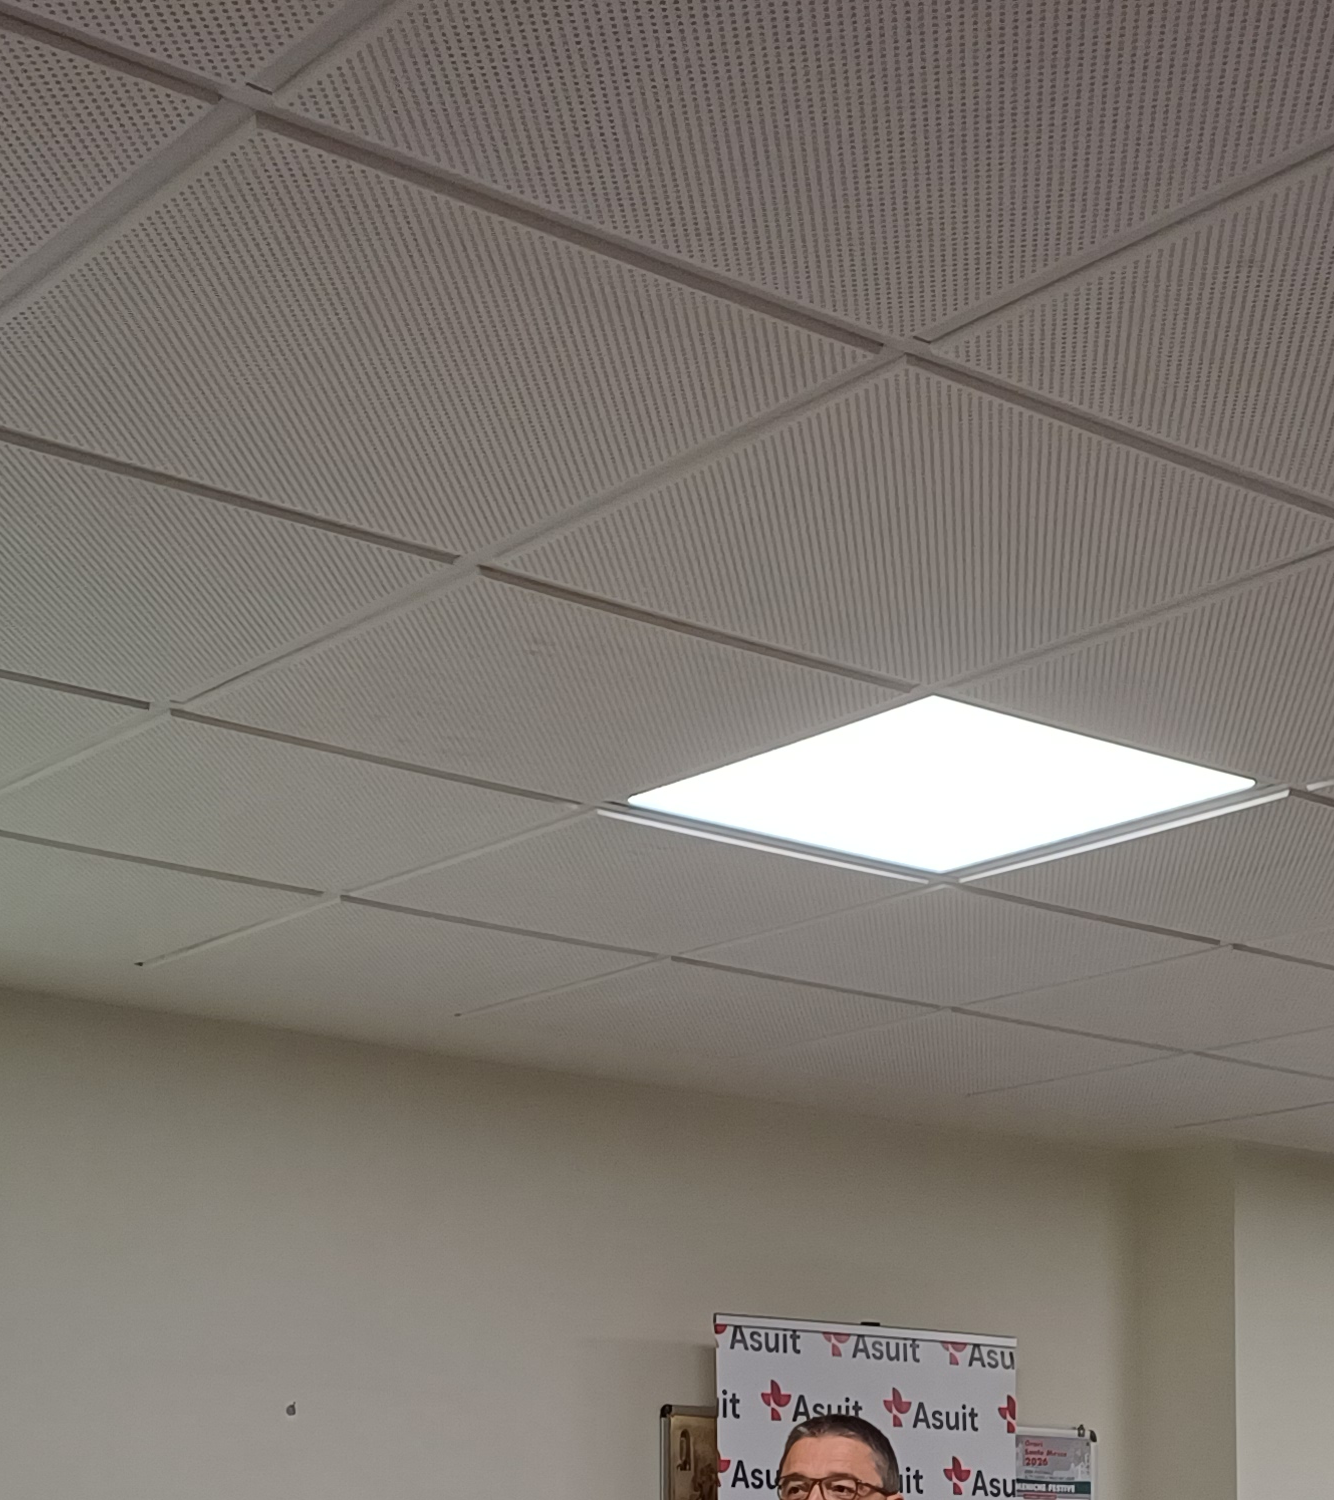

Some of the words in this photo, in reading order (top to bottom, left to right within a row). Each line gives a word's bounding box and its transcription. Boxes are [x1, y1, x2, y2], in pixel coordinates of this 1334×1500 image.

[729, 1325, 802, 1355] Asuit
[851, 1334, 921, 1363] Asuit
[968, 1344, 1015, 1370] Asu
[912, 1402, 979, 1432] Asuit
[971, 1469, 1016, 1498] Asu
